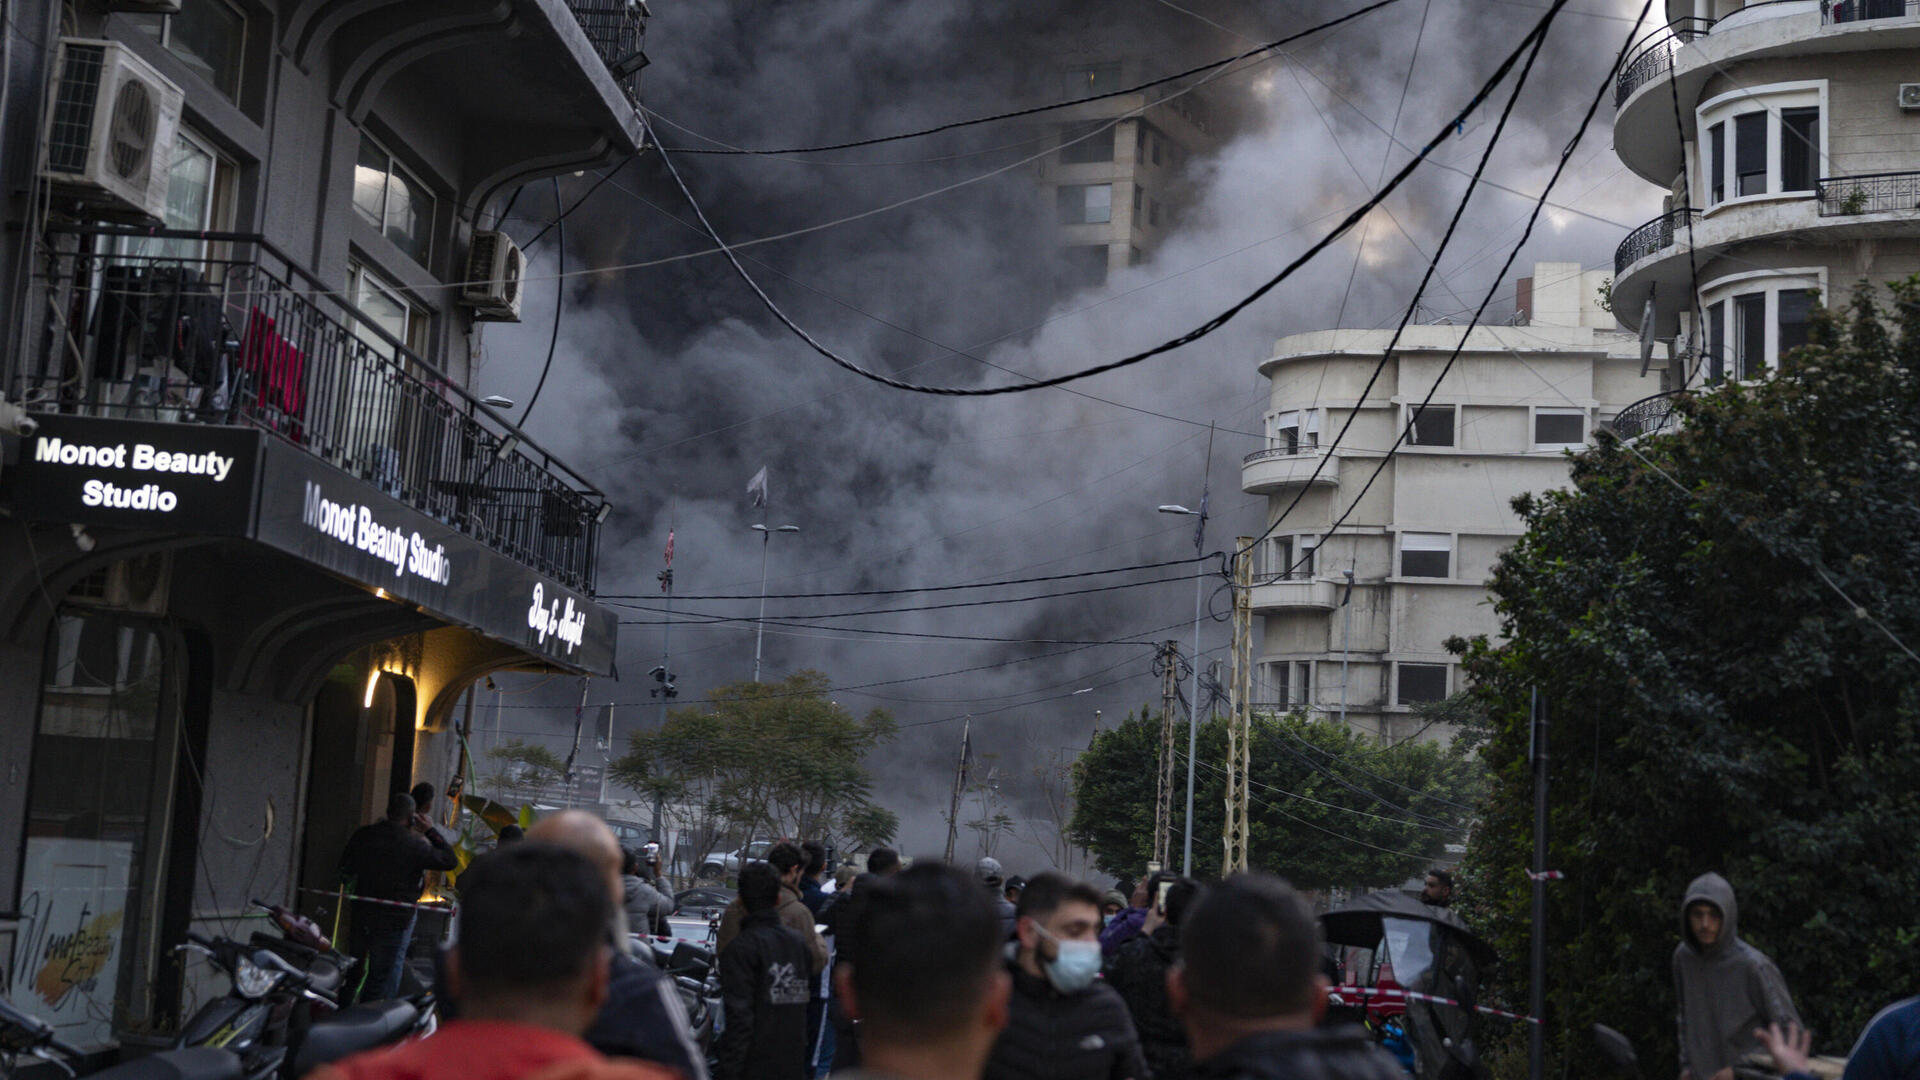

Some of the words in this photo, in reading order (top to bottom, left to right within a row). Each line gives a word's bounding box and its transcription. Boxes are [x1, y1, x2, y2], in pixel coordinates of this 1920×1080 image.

[35, 437, 127, 468] Monot
[132, 444, 234, 482] Beauty
[82, 479, 178, 512] Studio
[303, 480, 356, 545] Monot
[357, 505, 409, 577] Beauty
[408, 531, 451, 586] Studio
[528, 582, 550, 645] Day
[557, 596, 586, 655] Night
